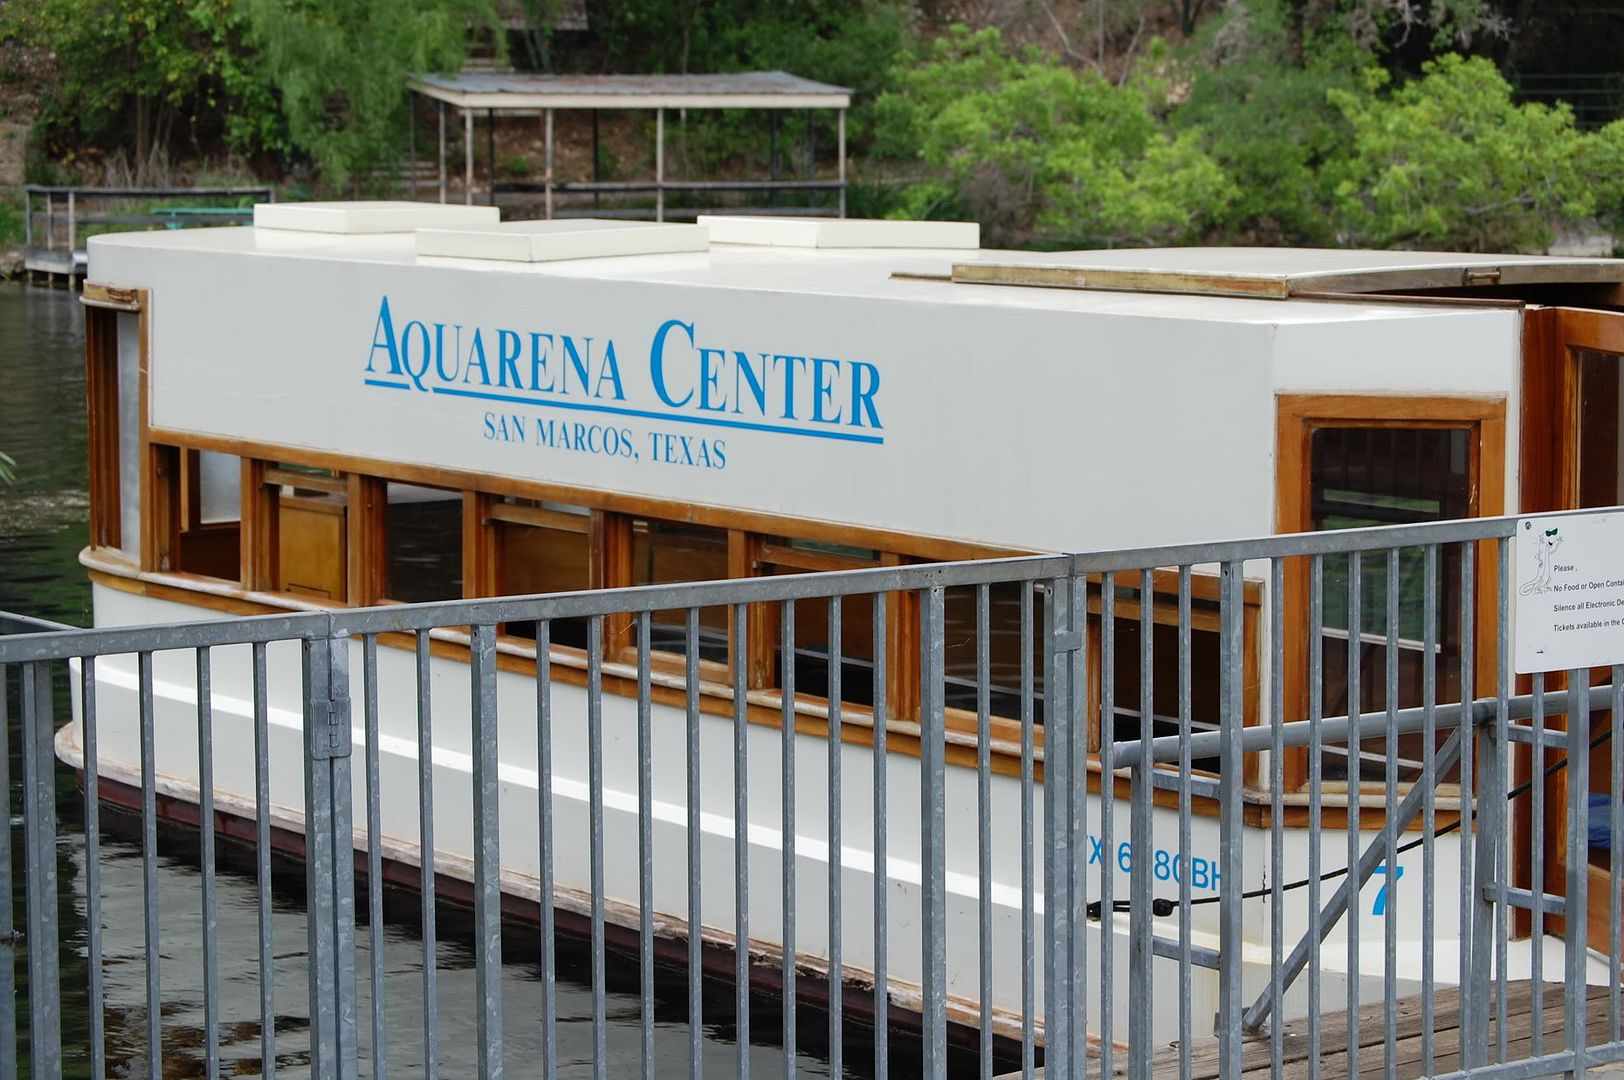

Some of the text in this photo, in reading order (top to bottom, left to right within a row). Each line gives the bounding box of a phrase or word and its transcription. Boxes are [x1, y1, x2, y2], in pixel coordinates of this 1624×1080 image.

[364, 296, 884, 430] AQUARENA CENTER
[483, 411, 727, 470] SAN MARCOS, TEXAS
[1588, 582, 1605, 590] Open
[1553, 604, 1576, 612] Silence
[1585, 601, 1615, 609] Electronic
[1553, 623, 1575, 632] Tickets
[1576, 621, 1602, 629] available
[1372, 865, 1404, 916] 7
